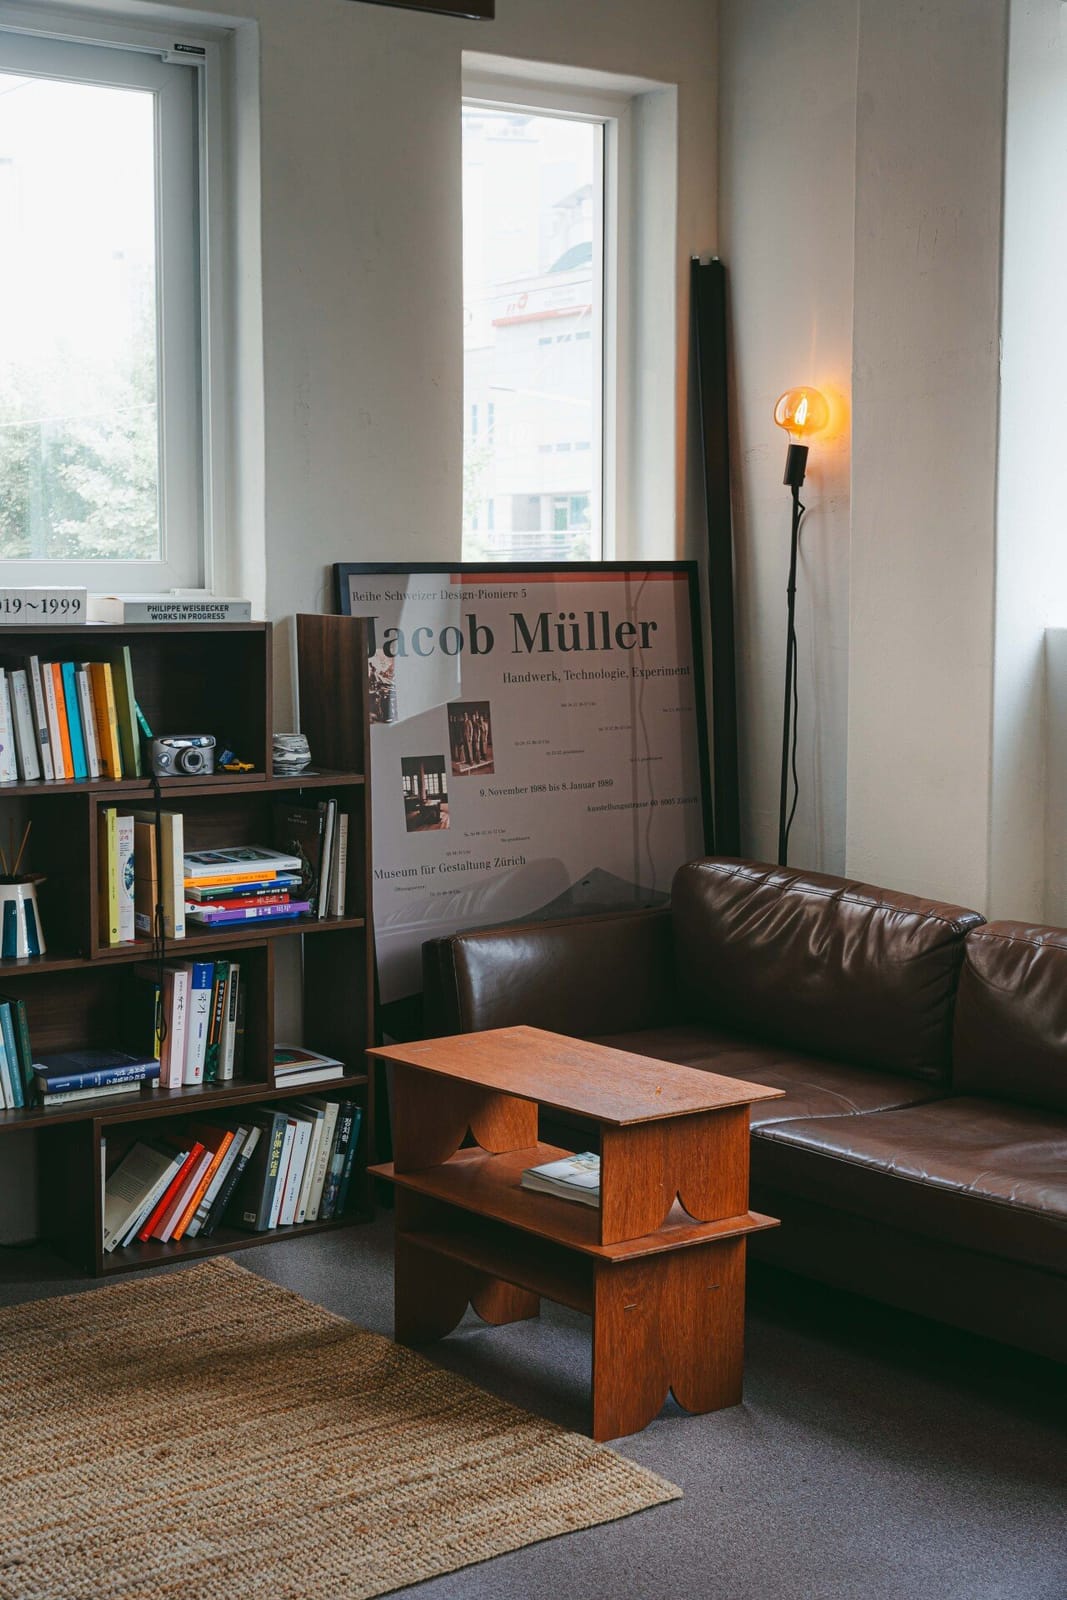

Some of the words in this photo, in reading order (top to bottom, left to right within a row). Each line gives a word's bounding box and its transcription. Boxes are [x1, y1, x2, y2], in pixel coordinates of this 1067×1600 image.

[352, 591, 382, 601] Reihe
[384, 590, 436, 601] Schweizer
[440, 589, 518, 601] Design-Pioniere
[521, 588, 527, 598] 5
[0, 598, 81, 614] 19~1999
[147, 604, 181, 612] PHILIPPE
[182, 604, 229, 612] WEISBECKER
[150, 612, 177, 620] WORKS
[187, 612, 225, 620] PROGRESS
[368, 613, 494, 658] Jacob
[509, 611, 657, 654] Müller
[503, 671, 561, 684] Handwerk,
[563, 668, 629, 682] Technologie,
[632, 665, 690, 680] Experiment
[479, 789, 487, 797] 9.
[488, 785, 528, 797] November
[530, 784, 547, 793] 1988
[548, 783, 560, 792] bis
[561, 782, 568, 791] 8.
[569, 781, 595, 791] Januar
[373, 868, 418, 880] Museum
[421, 864, 436, 876] für
[438, 860, 491, 874] Gestaltung
[493, 855, 526, 868] Zürich
